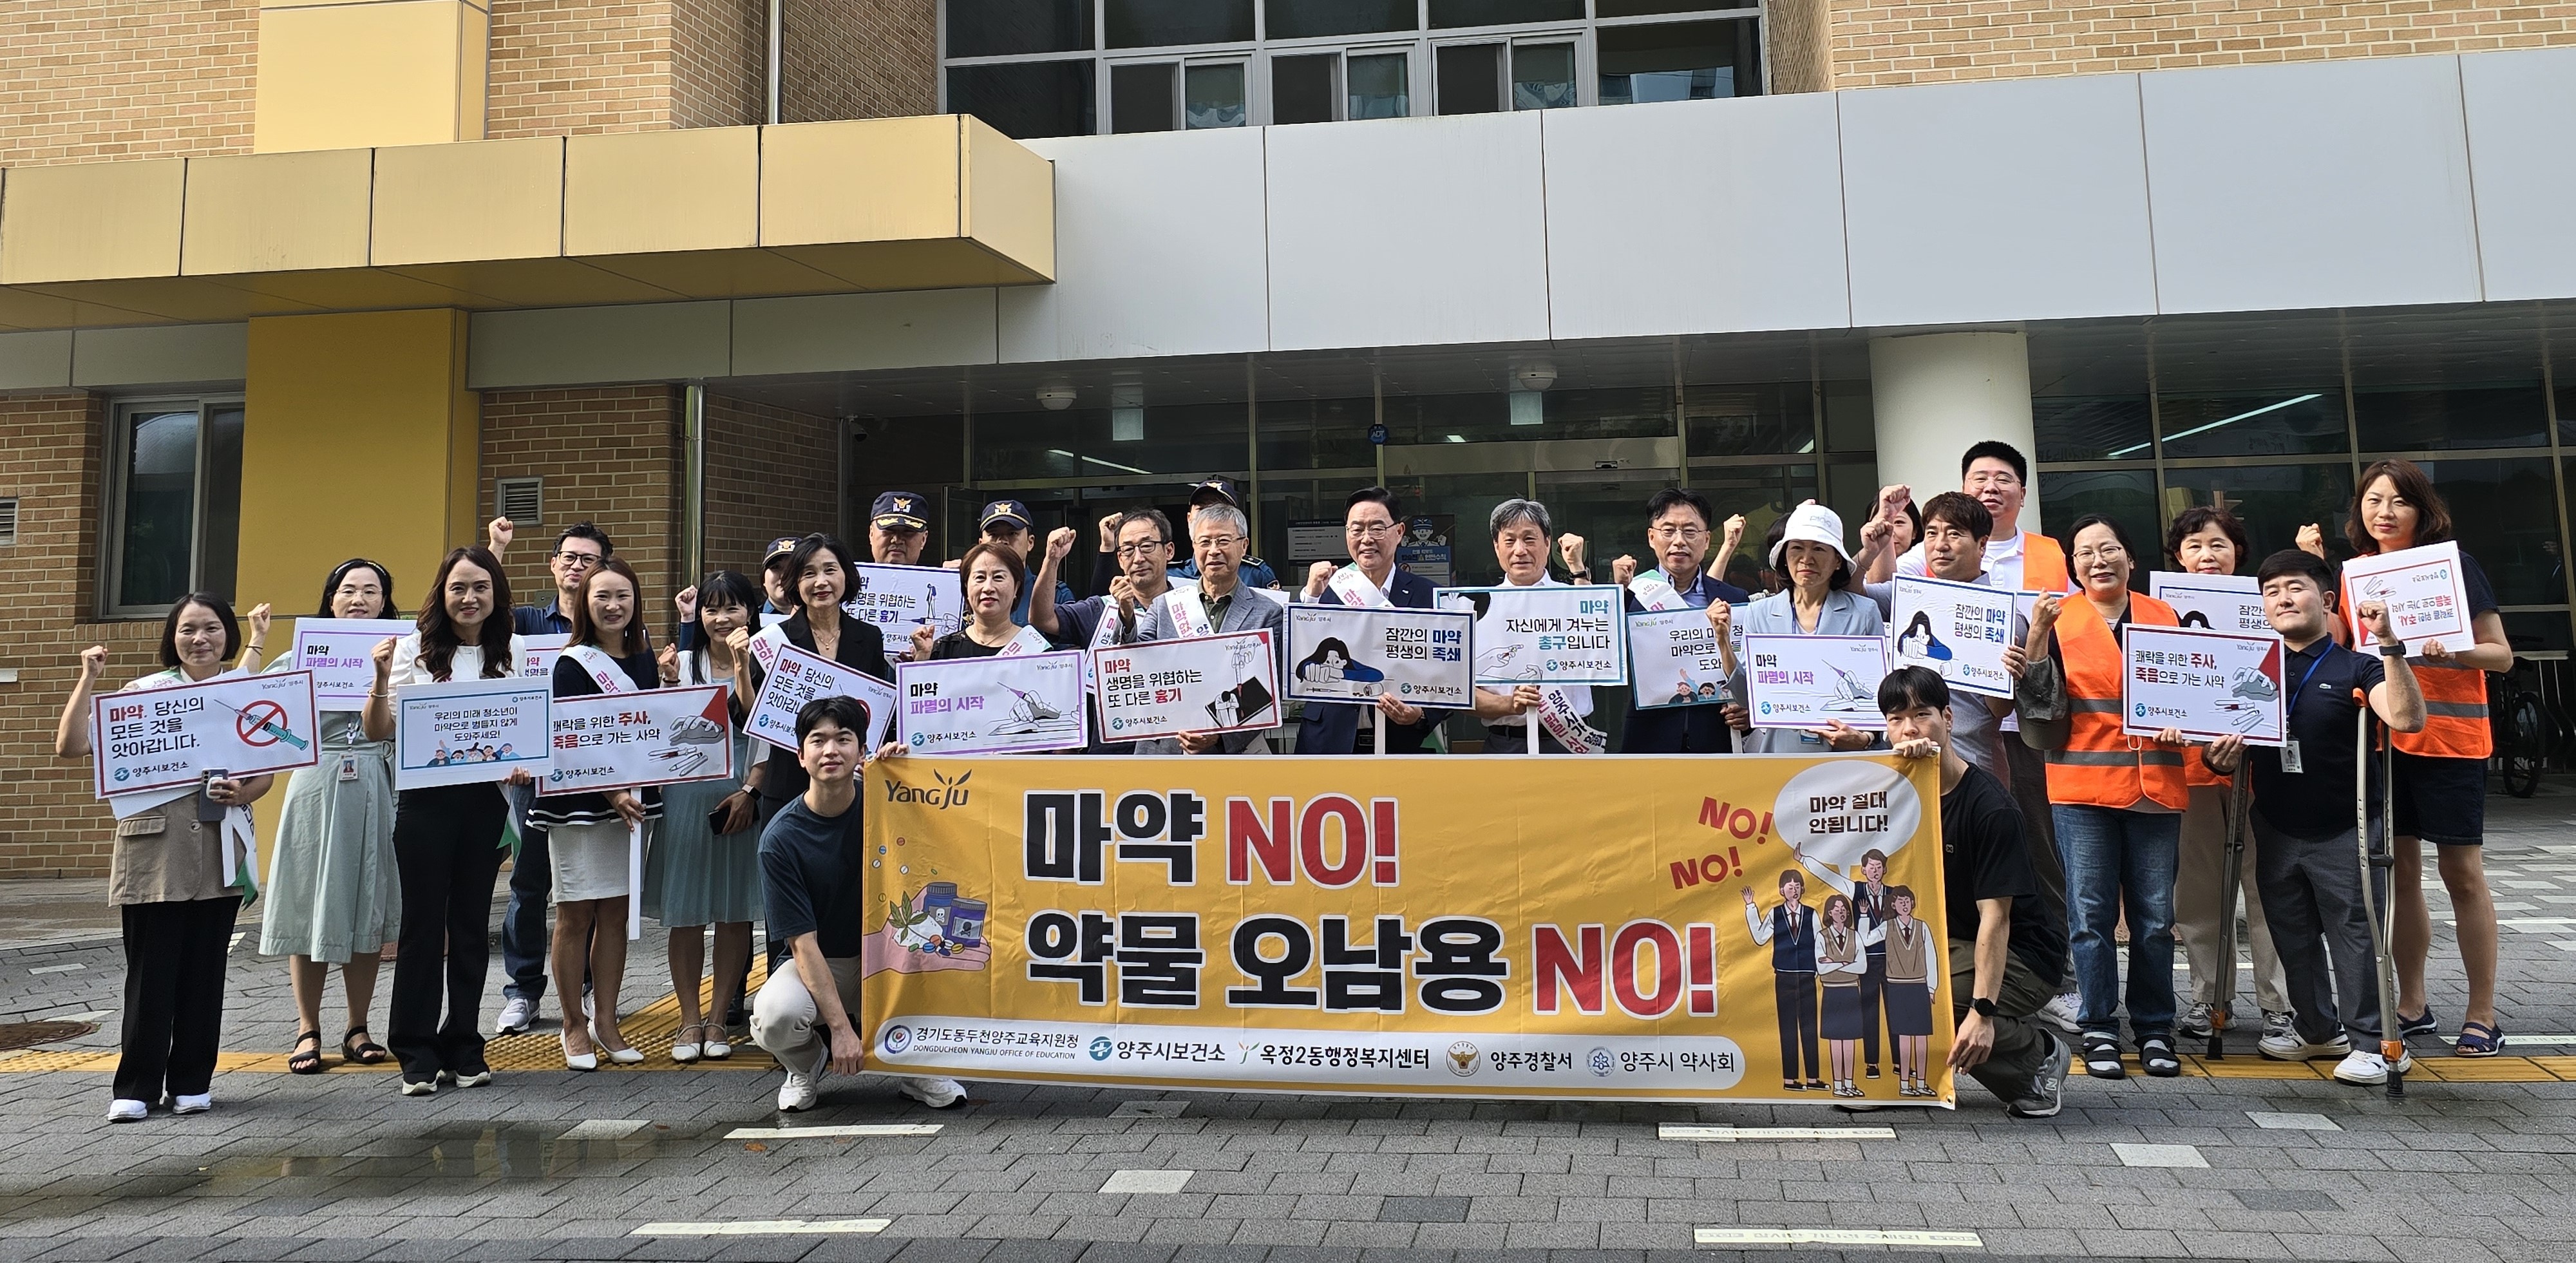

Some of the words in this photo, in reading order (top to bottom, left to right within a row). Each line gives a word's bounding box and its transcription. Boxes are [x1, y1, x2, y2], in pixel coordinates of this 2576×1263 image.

[878, 593, 916, 609] 위협하는
[1580, 600, 1609, 614] 마약
[2407, 600, 2421, 610] 가는
[858, 608, 876, 622] 다른
[879, 609, 898, 623] 흉기
[1955, 603, 1983, 622] 잠깐의
[1985, 608, 2006, 625] 마약
[1506, 618, 1562, 633] 자신에게
[1566, 618, 1609, 632] 겨누는
[1954, 622, 1982, 640] 평생의
[1985, 627, 2005, 644] 족쇄
[1385, 628, 1428, 643] 잠깐의
[1432, 629, 1462, 644] 마약
[1538, 635, 1611, 650] 총구입니다
[1669, 629, 1703, 642] 우리의
[307, 645, 329, 656] 마약
[1385, 645, 1428, 660] 평생의
[1432, 647, 1461, 662] 족쇄
[1671, 643, 1716, 658] 마약으로
[305, 657, 338, 668] 파멸의
[341, 658, 364, 669] 시작
[1104, 658, 1131, 674] 마약
[1559, 660, 1612, 671] 양주시보건소
[1756, 654, 1777, 668] 마약
[2136, 650, 2164, 665] 쾌락을
[2168, 653, 2188, 666] 위한
[2190, 653, 2217, 670] 주사,
[804, 667, 835, 690] 당신의
[1106, 674, 1145, 691] 생명을
[1149, 669, 1202, 687] 위협하는
[1757, 670, 1790, 685] 파멸의
[1793, 671, 1814, 685] 시작
[1971, 667, 2005, 681] 양주시보건소
[2136, 667, 2179, 685] 죽음으로
[2181, 673, 2202, 687] 가는
[2204, 675, 2225, 688] 사약
[772, 674, 795, 694] 모든
[794, 683, 817, 701] 것을
[910, 683, 938, 698] 마약
[1413, 684, 1463, 696] 양주시보건소
[911, 698, 952, 714] 파멸의
[956, 696, 985, 711] 시작
[1108, 694, 1121, 708] 또
[1125, 690, 1151, 707] 다른
[1155, 687, 1182, 703] 흉기
[154, 696, 205, 717] 당신의
[434, 710, 461, 721] 우리의
[462, 708, 480, 719] 미래
[483, 707, 518, 718] 청소년이
[1772, 703, 1812, 714] 양주시보건소
[2147, 706, 2188, 718] 양주시보건소
[434, 721, 469, 732] 마약으로
[500, 717, 518, 728] 않게
[589, 715, 614, 728] 위한
[618, 710, 652, 726] 주사,
[1125, 716, 1168, 728] 양주시보건소
[111, 724, 144, 741] 모든
[149, 717, 184, 736] 것을
[454, 730, 500, 742] 도와주세요!
[553, 734, 603, 750] 죽음으로
[610, 730, 632, 744] 가는
[636, 728, 660, 741] 사약
[927, 731, 978, 744] 양주시보건소
[111, 733, 201, 760] 앗아갑니다.
[132, 761, 189, 779] 양주시보건소
[565, 766, 615, 779] 양주시보건소
[1810, 793, 1846, 815] 마약
[1851, 790, 1888, 810] 절대
[1699, 795, 1773, 846] NO!
[1809, 813, 1889, 835] 안됩니다!
[1025, 791, 1206, 885] 마약
[1227, 793, 1397, 887] NO!
[1670, 846, 1743, 890] NO!
[1028, 911, 1204, 1007] 약물
[1226, 915, 1509, 1015] 오남용
[1533, 919, 1718, 1018] NO!
[916, 1027, 1079, 1049] 경기도동두천양주교육지원청
[913, 1045, 968, 1054] DONGDUCHEON
[971, 1047, 998, 1056] YANGJU
[999, 1049, 1023, 1058] OFFICE
[1036, 1051, 1076, 1060] EDUCATION
[1116, 1041, 1226, 1063] 양주시보건소
[1260, 1043, 1430, 1070] 옥정2동행정복지센터
[1490, 1051, 1573, 1072] 양주경찰서
[1620, 1051, 1674, 1074] 양주시
[1679, 1053, 1736, 1074] 약사회
